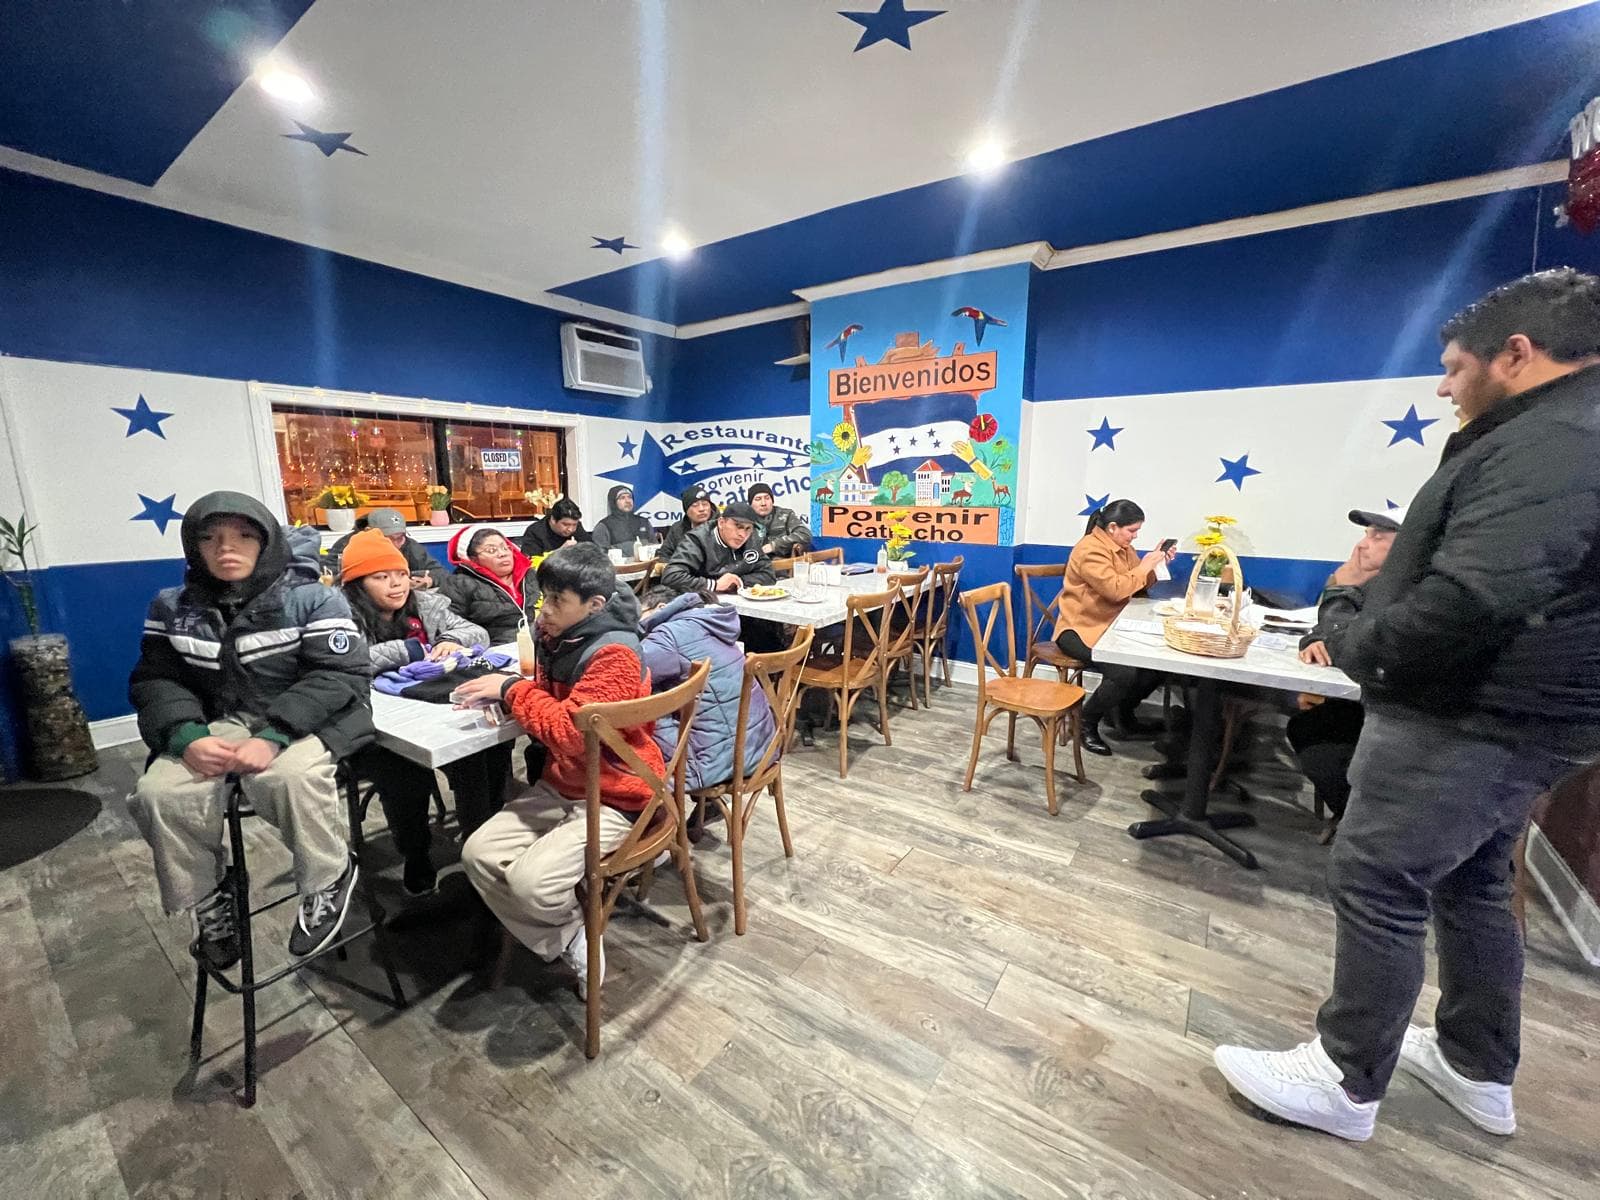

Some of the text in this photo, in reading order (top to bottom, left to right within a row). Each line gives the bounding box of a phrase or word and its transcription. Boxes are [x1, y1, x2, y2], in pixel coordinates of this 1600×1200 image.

[836, 360, 991, 397] Bienvenidos
[660, 424, 811, 455] Restaurante
[483, 452, 507, 463] CLOSED
[708, 475, 811, 506] Catcho
[828, 506, 990, 526] Porenir
[846, 522, 964, 542] Catrcho
